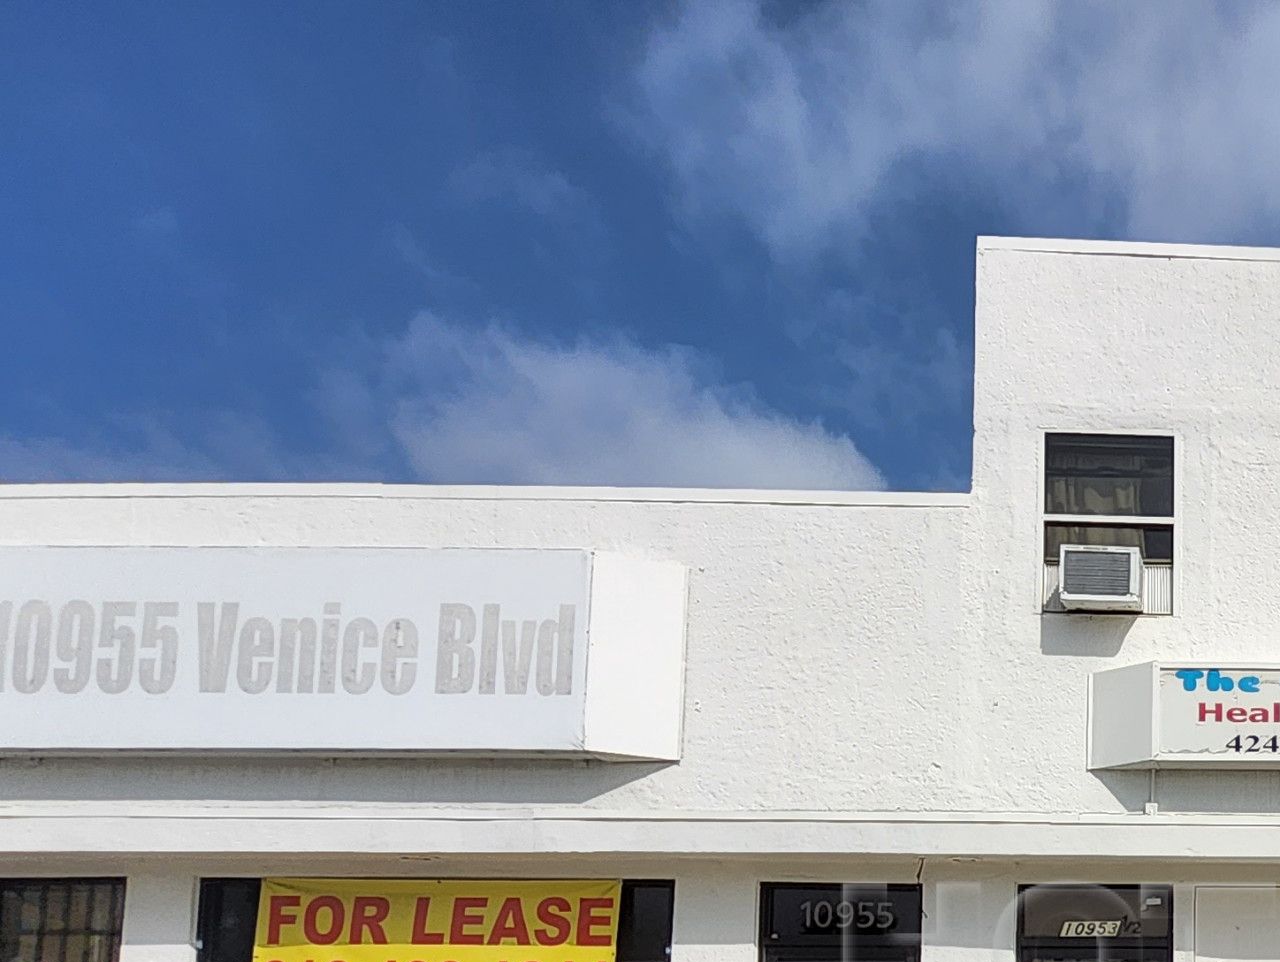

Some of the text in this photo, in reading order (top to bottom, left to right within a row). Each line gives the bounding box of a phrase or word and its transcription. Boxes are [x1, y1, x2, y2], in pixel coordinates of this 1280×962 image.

[0, 599, 577, 697] 0955 Venice Blvd
[1175, 669, 1261, 693] The
[266, 895, 615, 946] FOR LEASE
[801, 901, 894, 928] 10955
[1064, 923, 1118, 936] 10953
